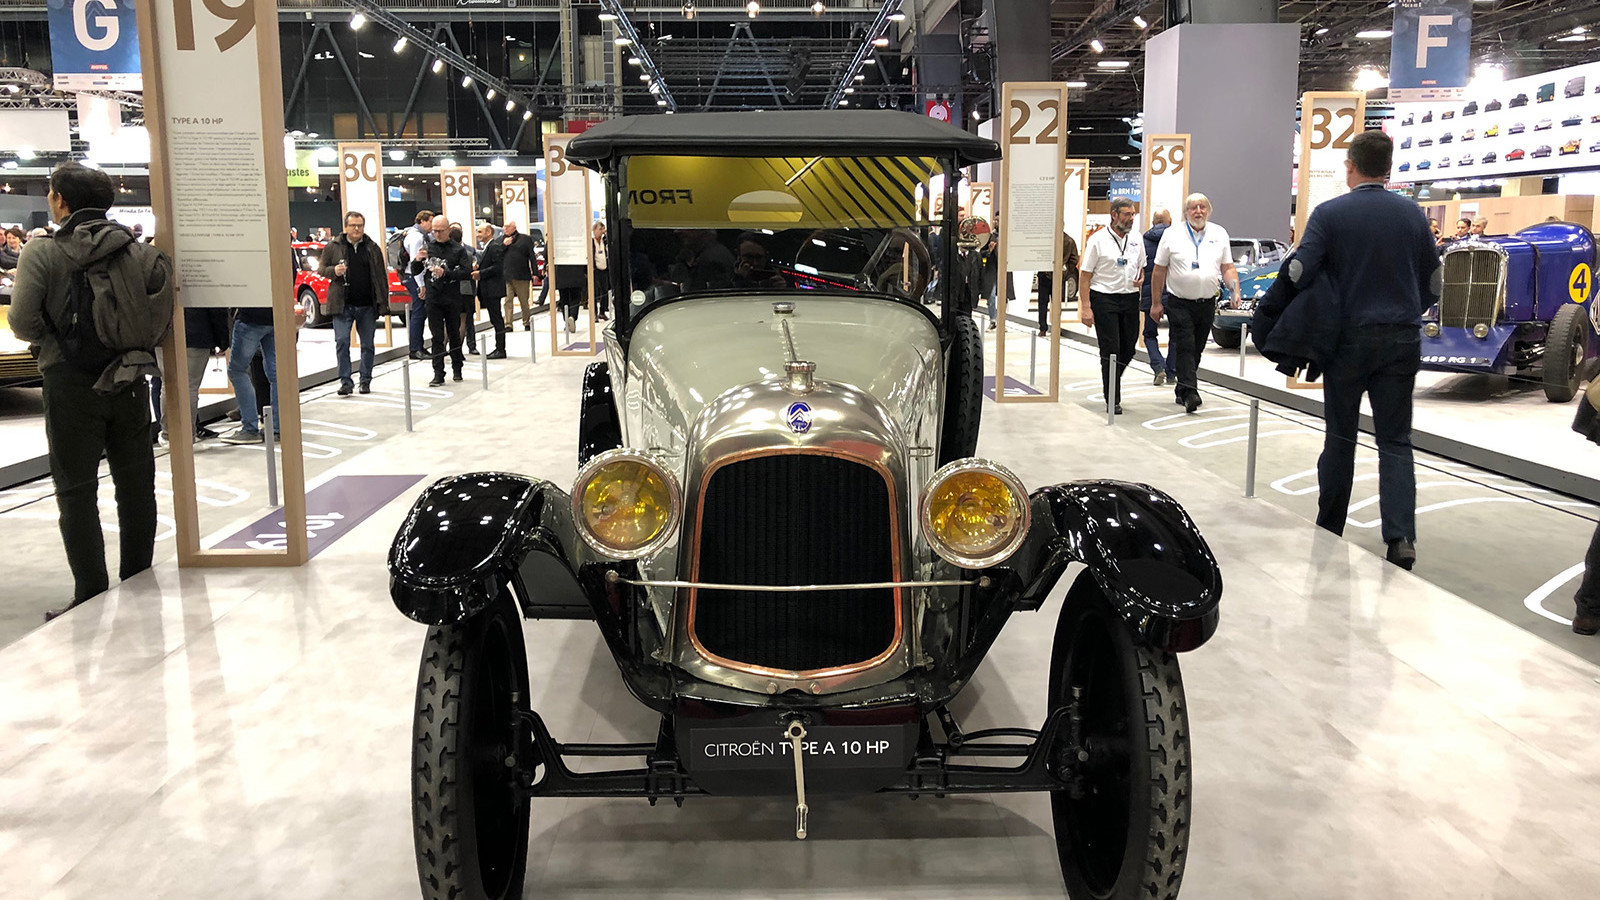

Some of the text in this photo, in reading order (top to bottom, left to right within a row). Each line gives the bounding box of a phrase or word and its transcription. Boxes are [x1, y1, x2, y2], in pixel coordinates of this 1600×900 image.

[73, 0, 120, 51] G
[1416, 15, 1453, 68] F
[171, 117, 191, 125] TYPE
[192, 117, 199, 125] A
[200, 117, 211, 125] 10
[1010, 99, 1059, 144] 22
[1310, 107, 1356, 149] 32
[344, 153, 377, 182] 80
[1151, 145, 1185, 175] 69
[445, 175, 469, 197] 88
[1064, 168, 1085, 191] 71
[505, 187, 526, 205] 94
[972, 188, 991, 206] 73
[1572, 268, 1587, 298] 4
[1447, 356, 1466, 364] RG
[704, 740, 774, 758] CITROËN
[822, 741, 836, 755] A
[841, 741, 862, 755] 10
[866, 740, 890, 754] HP
